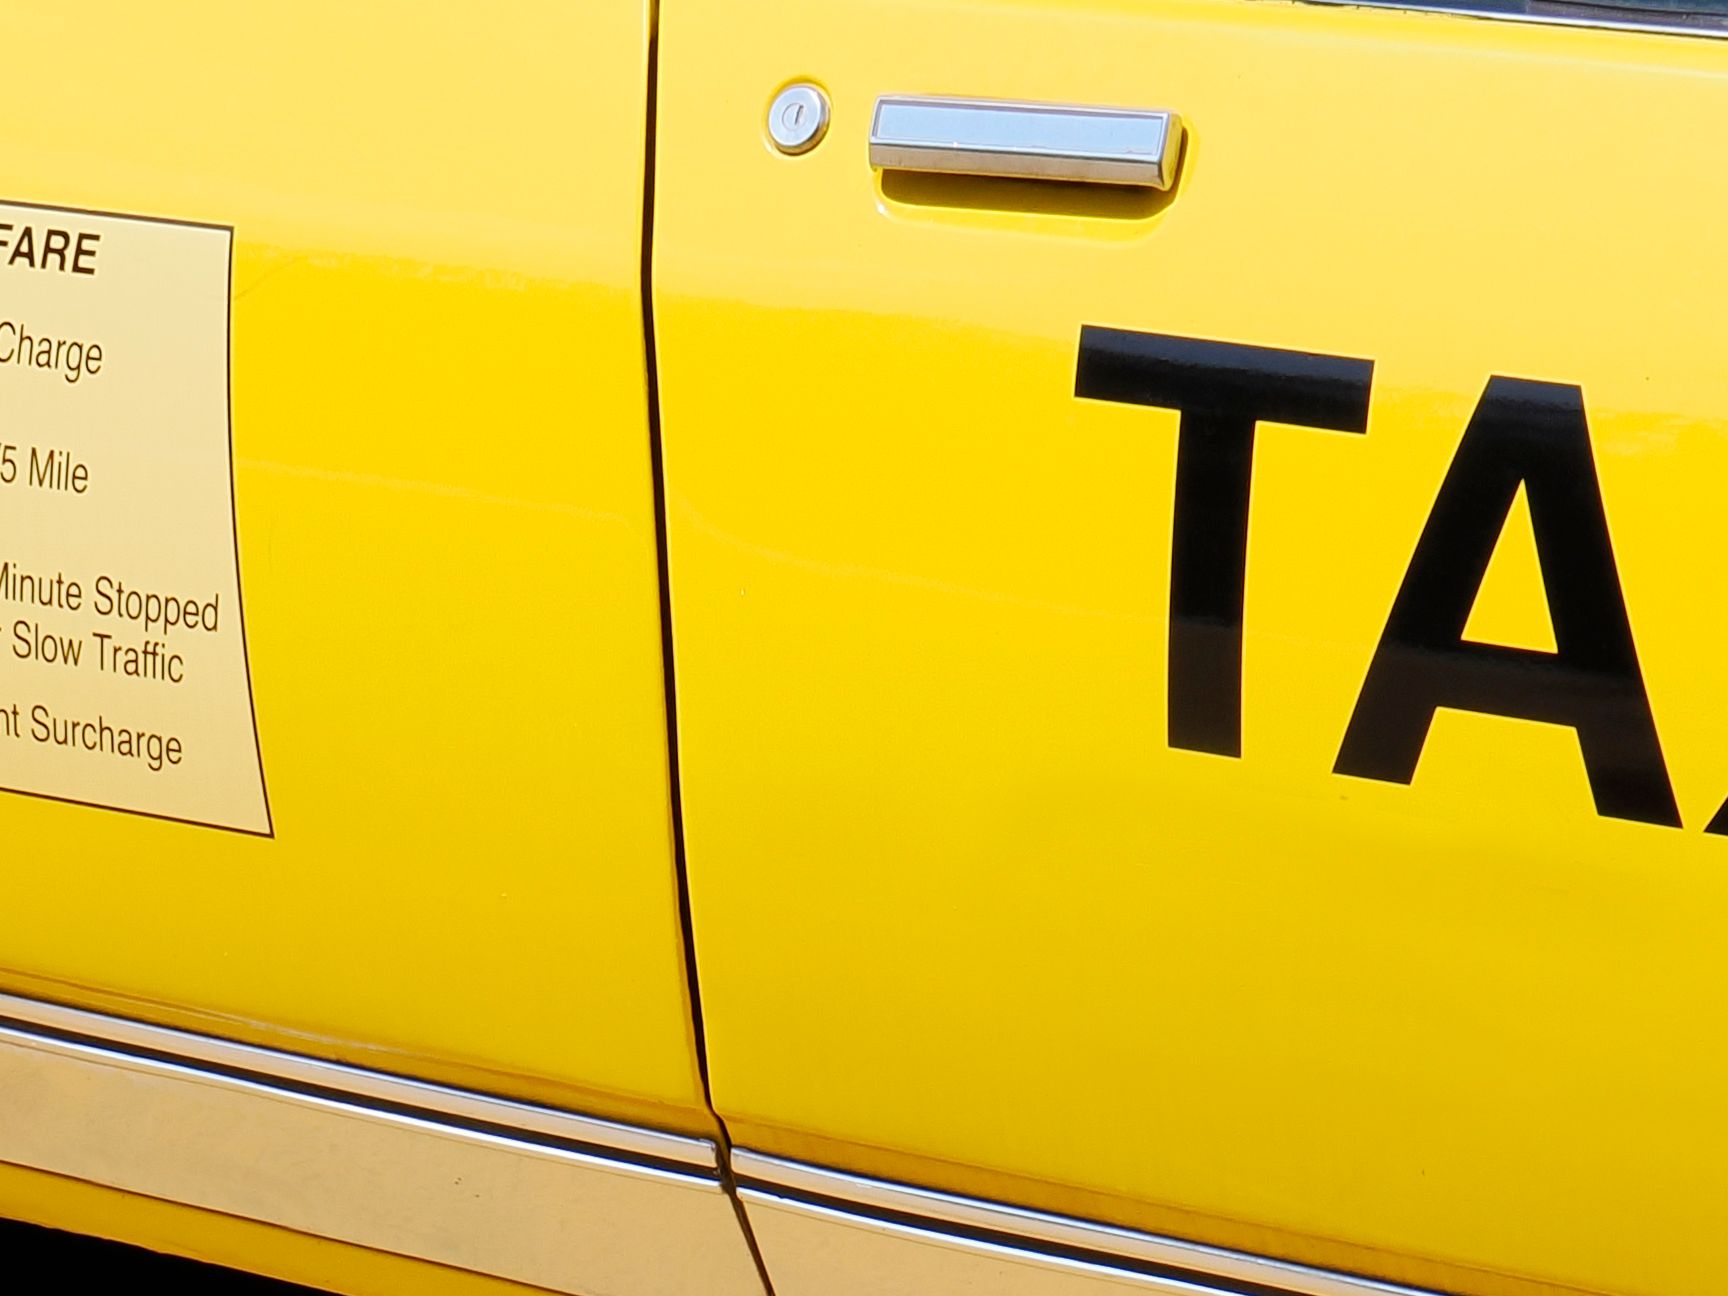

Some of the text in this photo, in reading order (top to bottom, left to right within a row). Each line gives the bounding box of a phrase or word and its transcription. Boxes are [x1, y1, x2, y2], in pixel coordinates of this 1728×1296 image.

[29, 446, 89, 494] Mile
[94, 575, 219, 636] Stopped
[12, 619, 83, 667] Slow
[92, 632, 184, 684] Traffic
[31, 704, 182, 772] Surcharge
